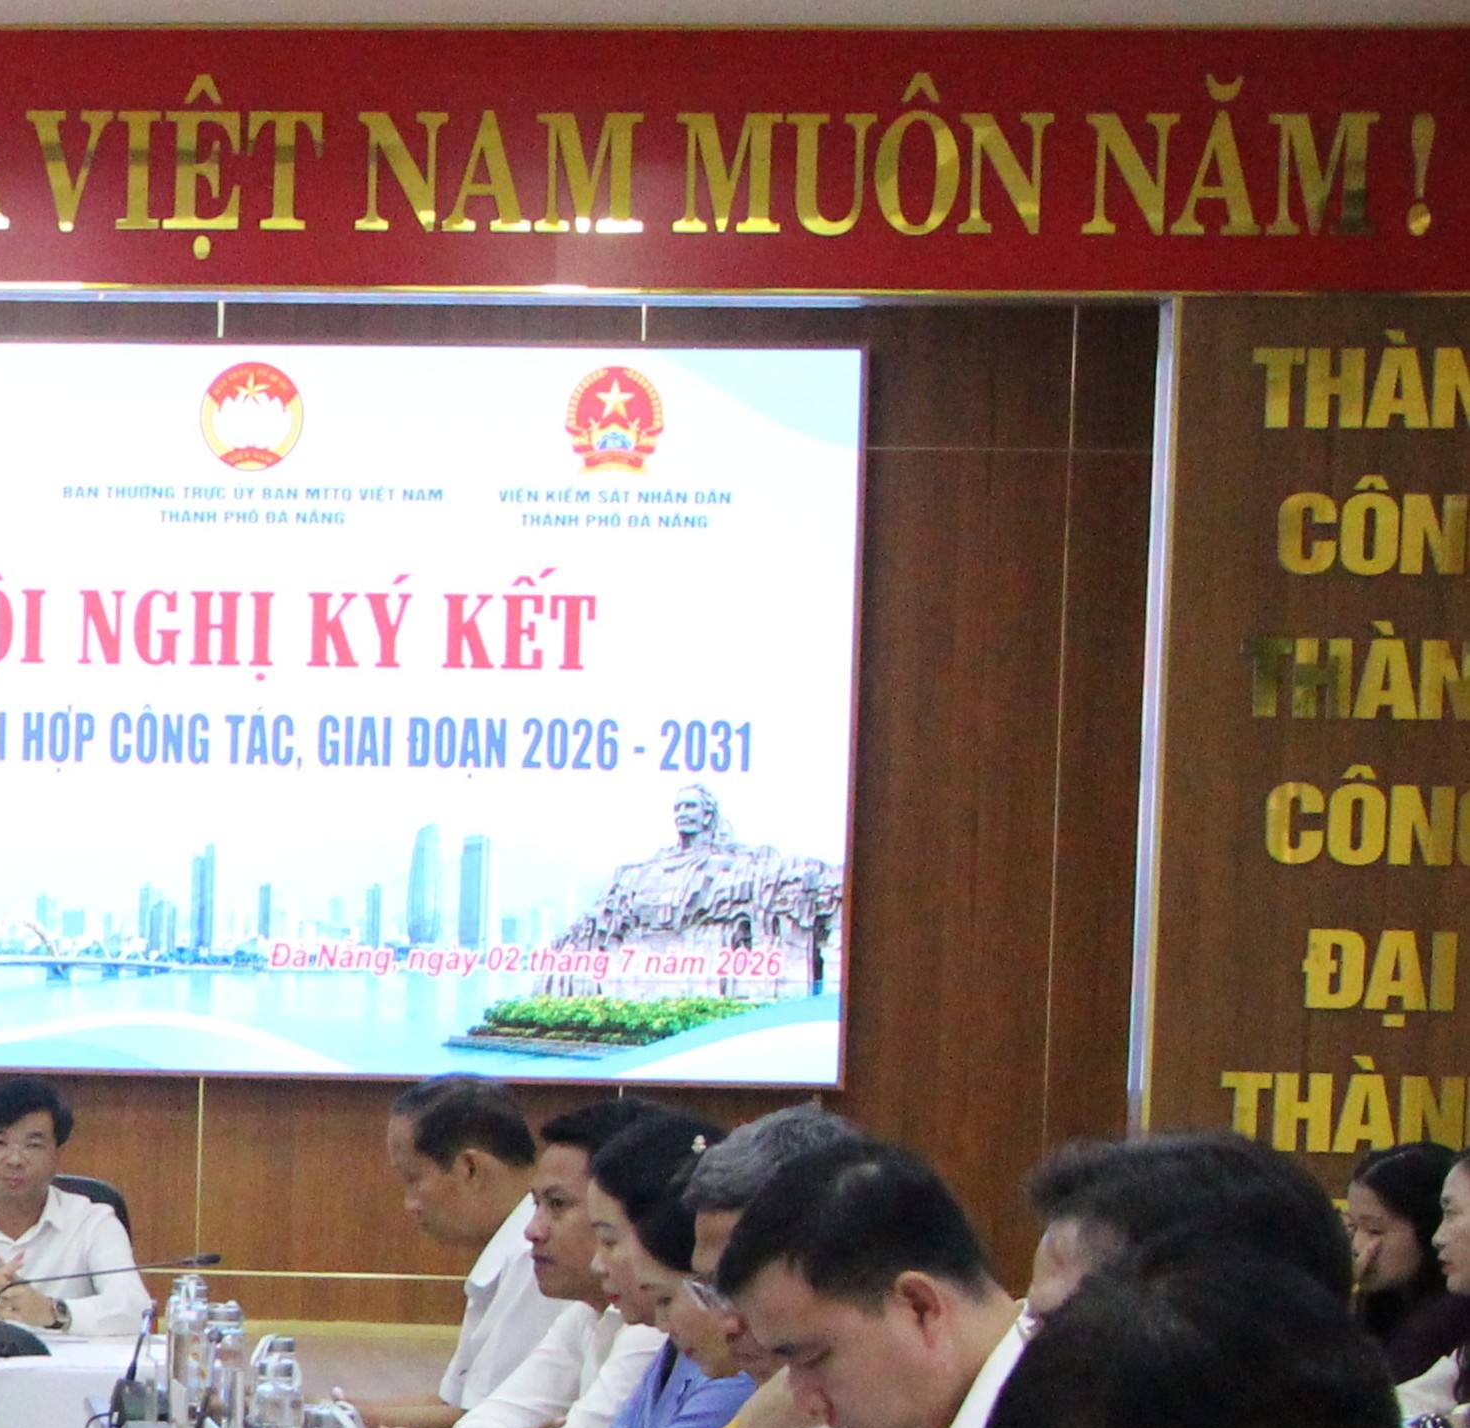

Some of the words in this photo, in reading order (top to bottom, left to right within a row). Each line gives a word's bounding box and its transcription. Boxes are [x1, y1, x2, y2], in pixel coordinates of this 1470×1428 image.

[26, 74, 323, 260] VIỆT
[354, 109, 644, 234] NAM
[672, 72, 1055, 236] MUÔN
[1081, 73, 1380, 237] NĂM
[62, 485, 100, 499] BAN
[262, 487, 299, 501] BAN
[305, 488, 353, 502] MTTQ
[402, 488, 444, 502] NAM
[77, 589, 275, 682] NGHỊ
[306, 574, 413, 669] KÝ
[441, 567, 597, 671] KẾT
[22, 704, 96, 773] HỢP
[110, 704, 211, 765] CÔNG
[225, 706, 302, 771] TÁC,
[317, 715, 393, 768] GIAI
[407, 717, 508, 779] ĐOẠN
[521, 719, 620, 771] 2026
[659, 720, 752, 773] 2031
[1265, 765, 1470, 866] CÔN
[270, 942, 307, 968] Đà
[409, 945, 478, 977] ngày
[487, 947, 521, 971] 02
[529, 944, 610, 980] tháng
[621, 949, 636, 974] 7
[644, 948, 706, 975] năm
[716, 951, 782, 976] 2026
[1302, 929, 1457, 1027] ĐẠI
[1221, 1055, 1470, 1153] THÀN
